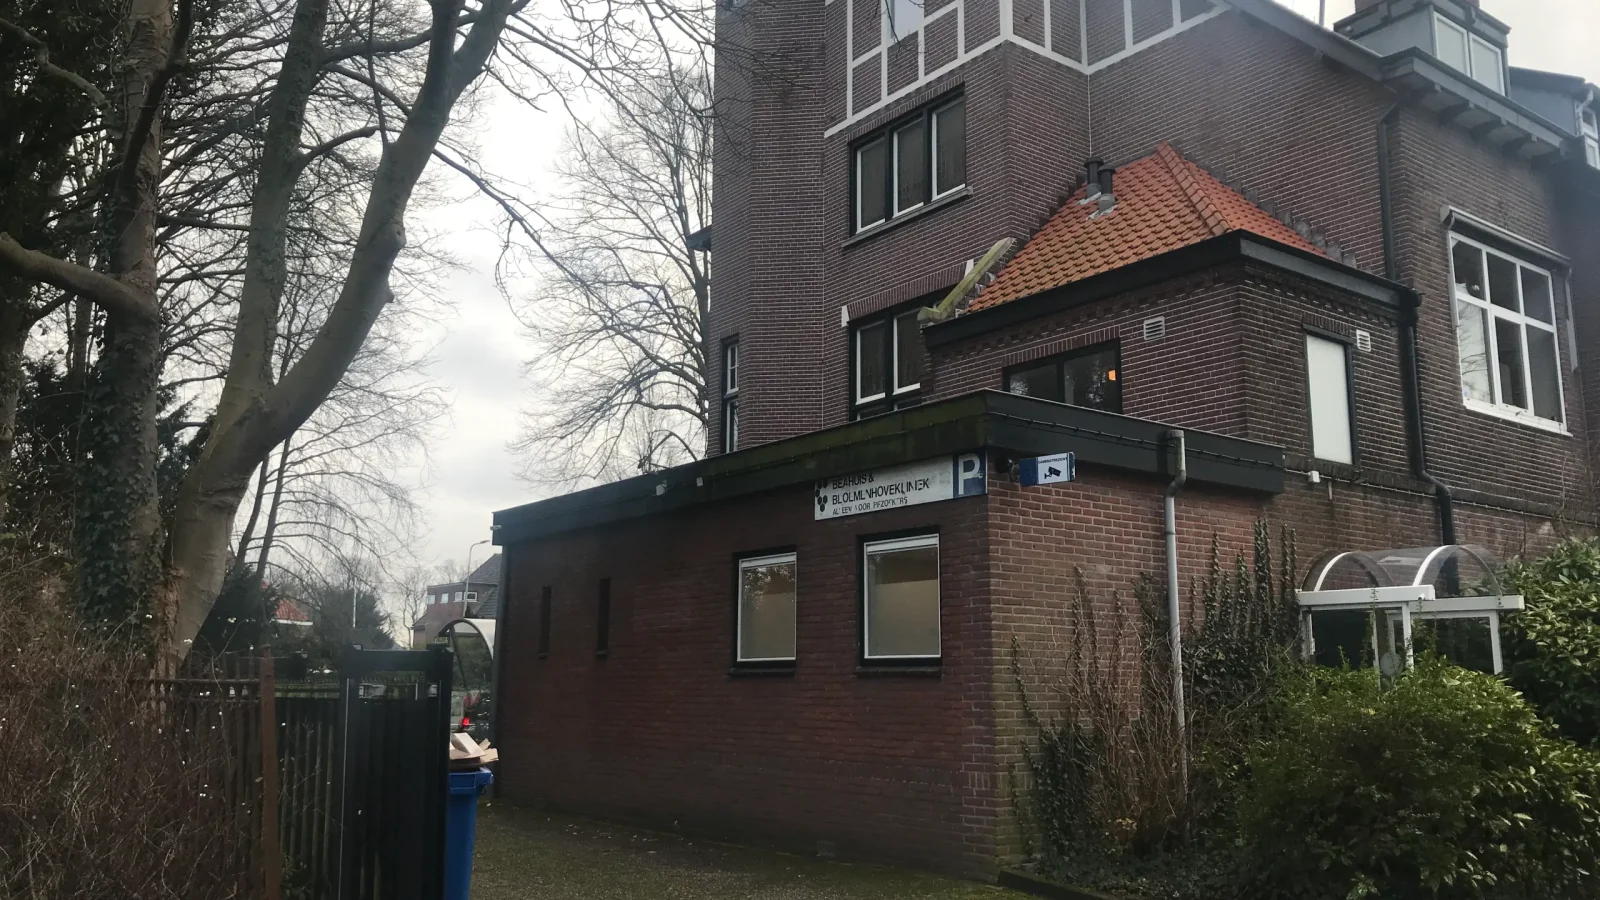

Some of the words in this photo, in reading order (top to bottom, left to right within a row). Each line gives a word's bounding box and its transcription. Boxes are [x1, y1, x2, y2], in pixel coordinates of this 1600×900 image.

[832, 474, 867, 490] BEAHUIS
[868, 472, 875, 483] &
[958, 453, 980, 495] P
